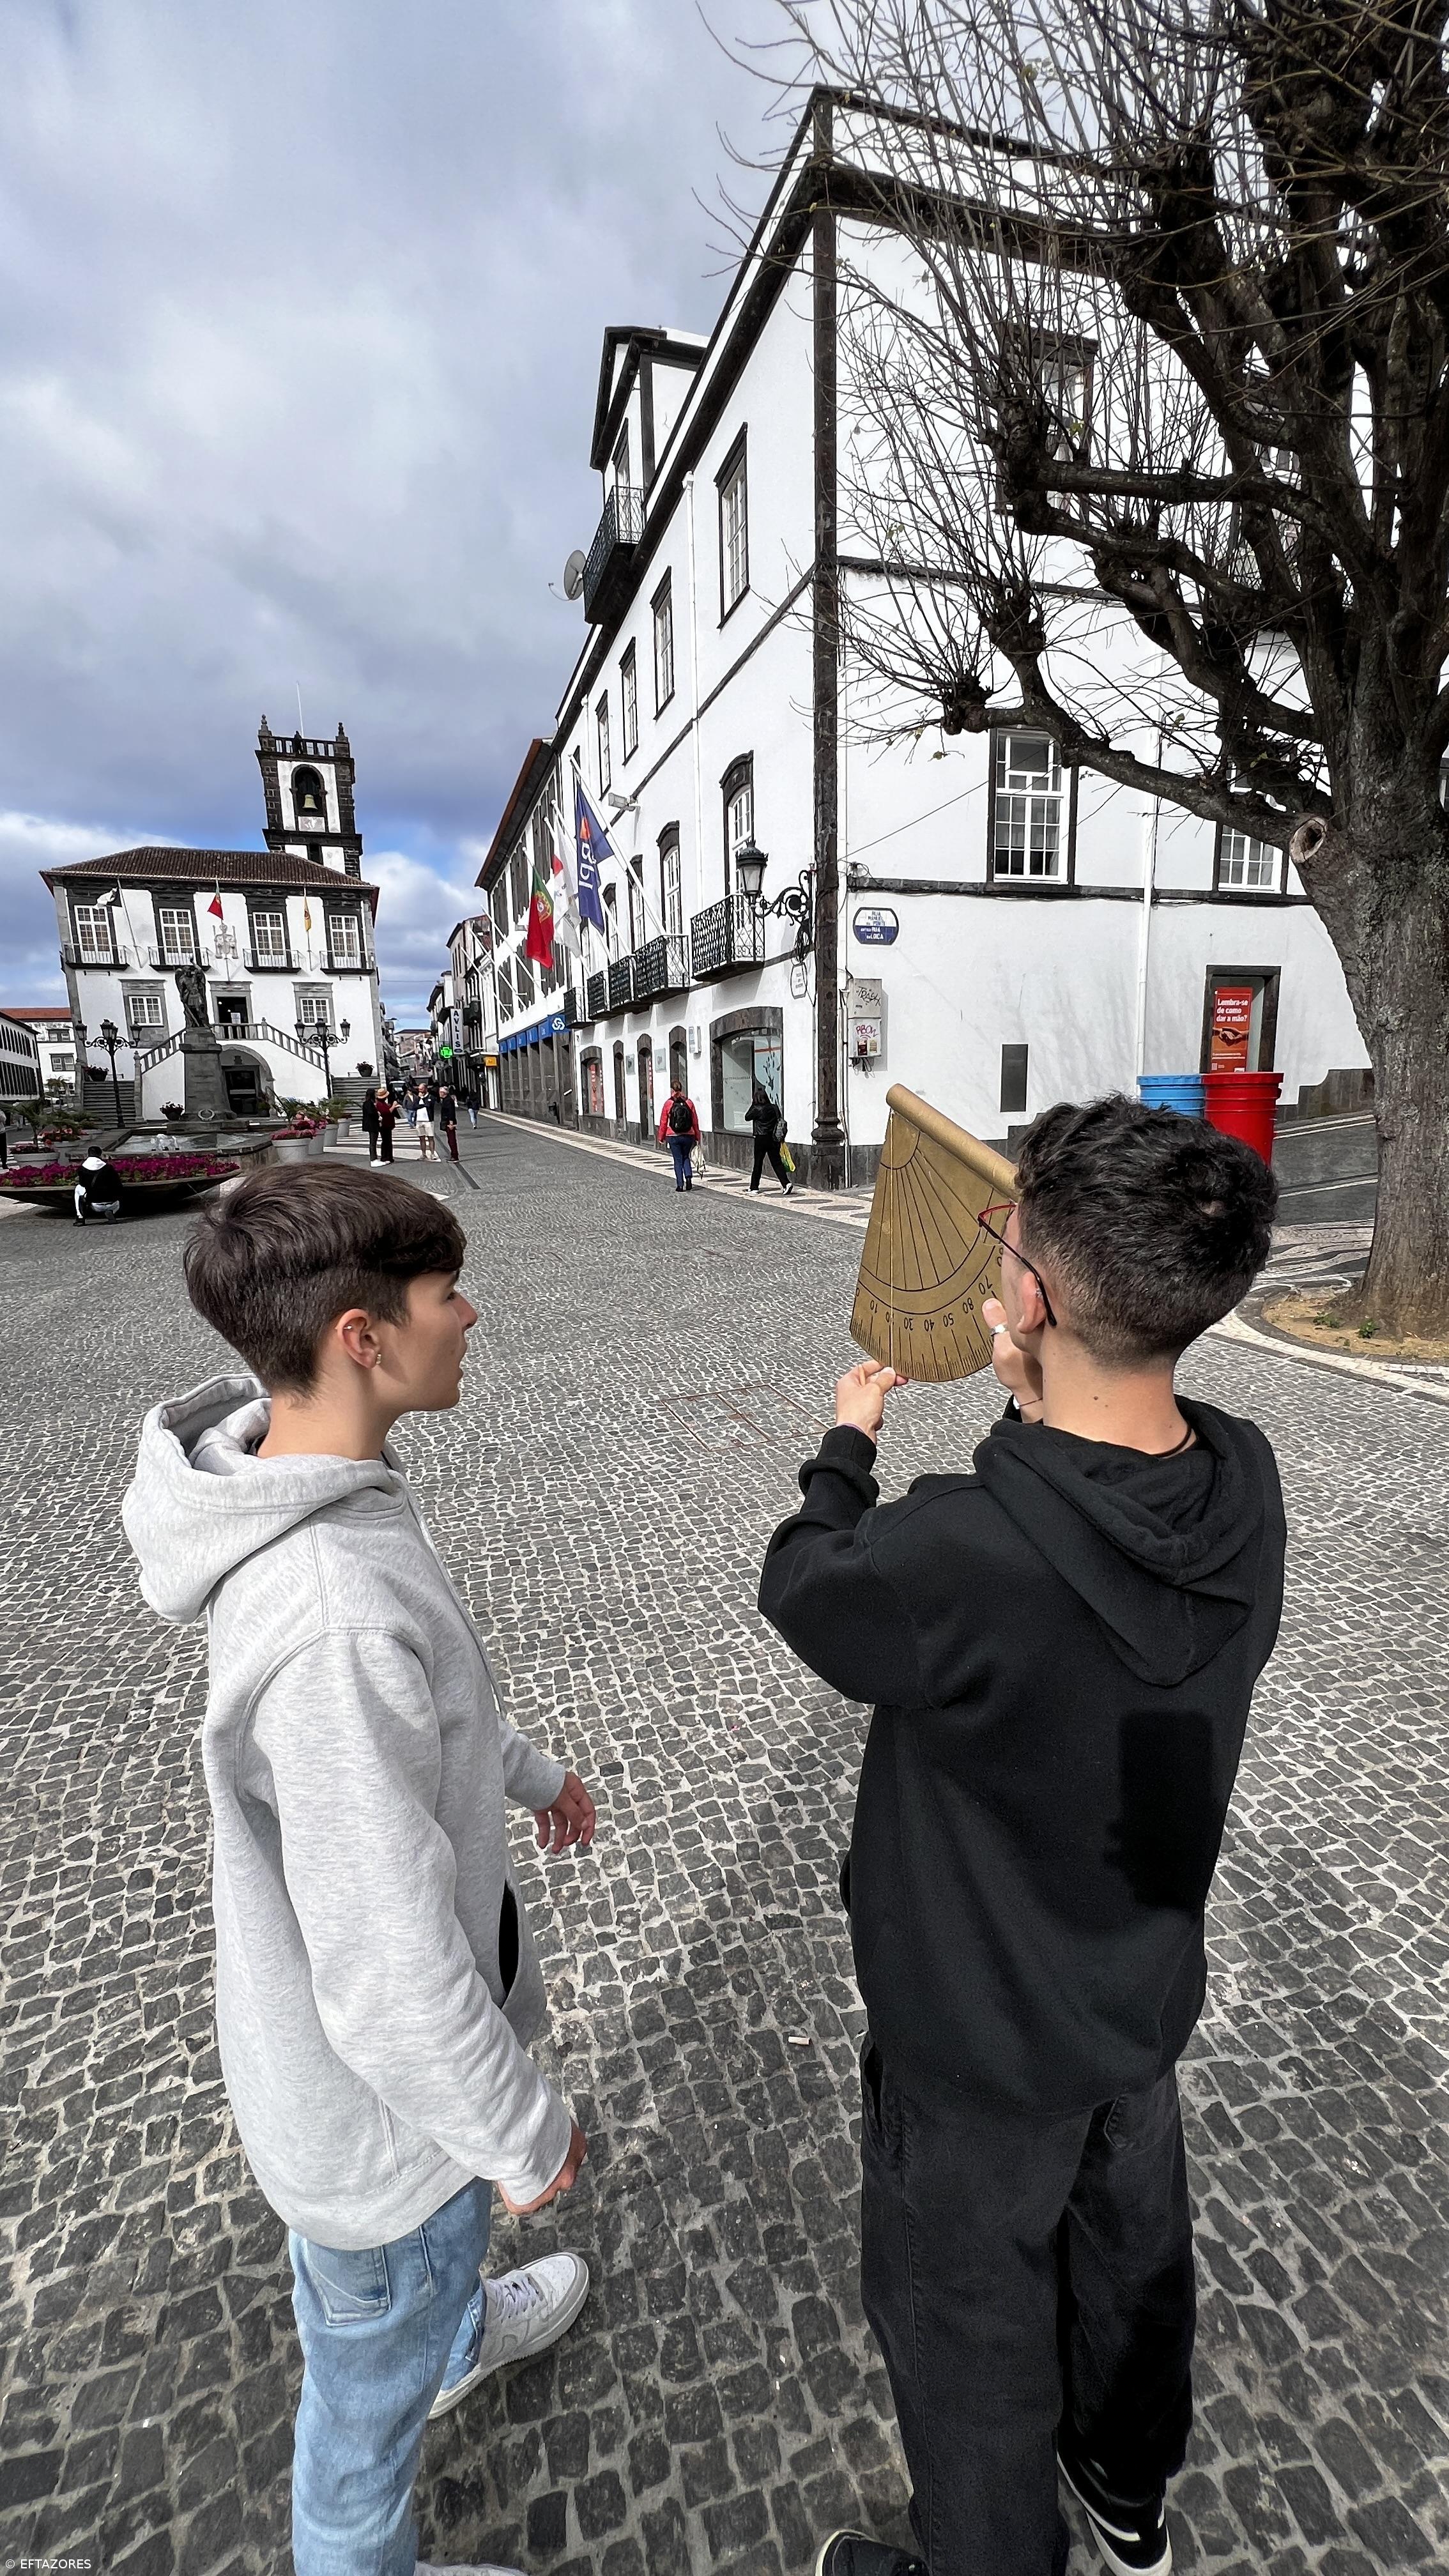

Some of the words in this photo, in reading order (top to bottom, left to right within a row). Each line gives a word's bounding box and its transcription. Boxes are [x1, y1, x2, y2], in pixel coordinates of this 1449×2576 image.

[979, 1275, 993, 1295] 70
[870, 1300, 878, 1314] 10
[903, 1317, 914, 1331] 30
[924, 1319, 935, 1332] 40
[943, 1313, 954, 1326] 50
